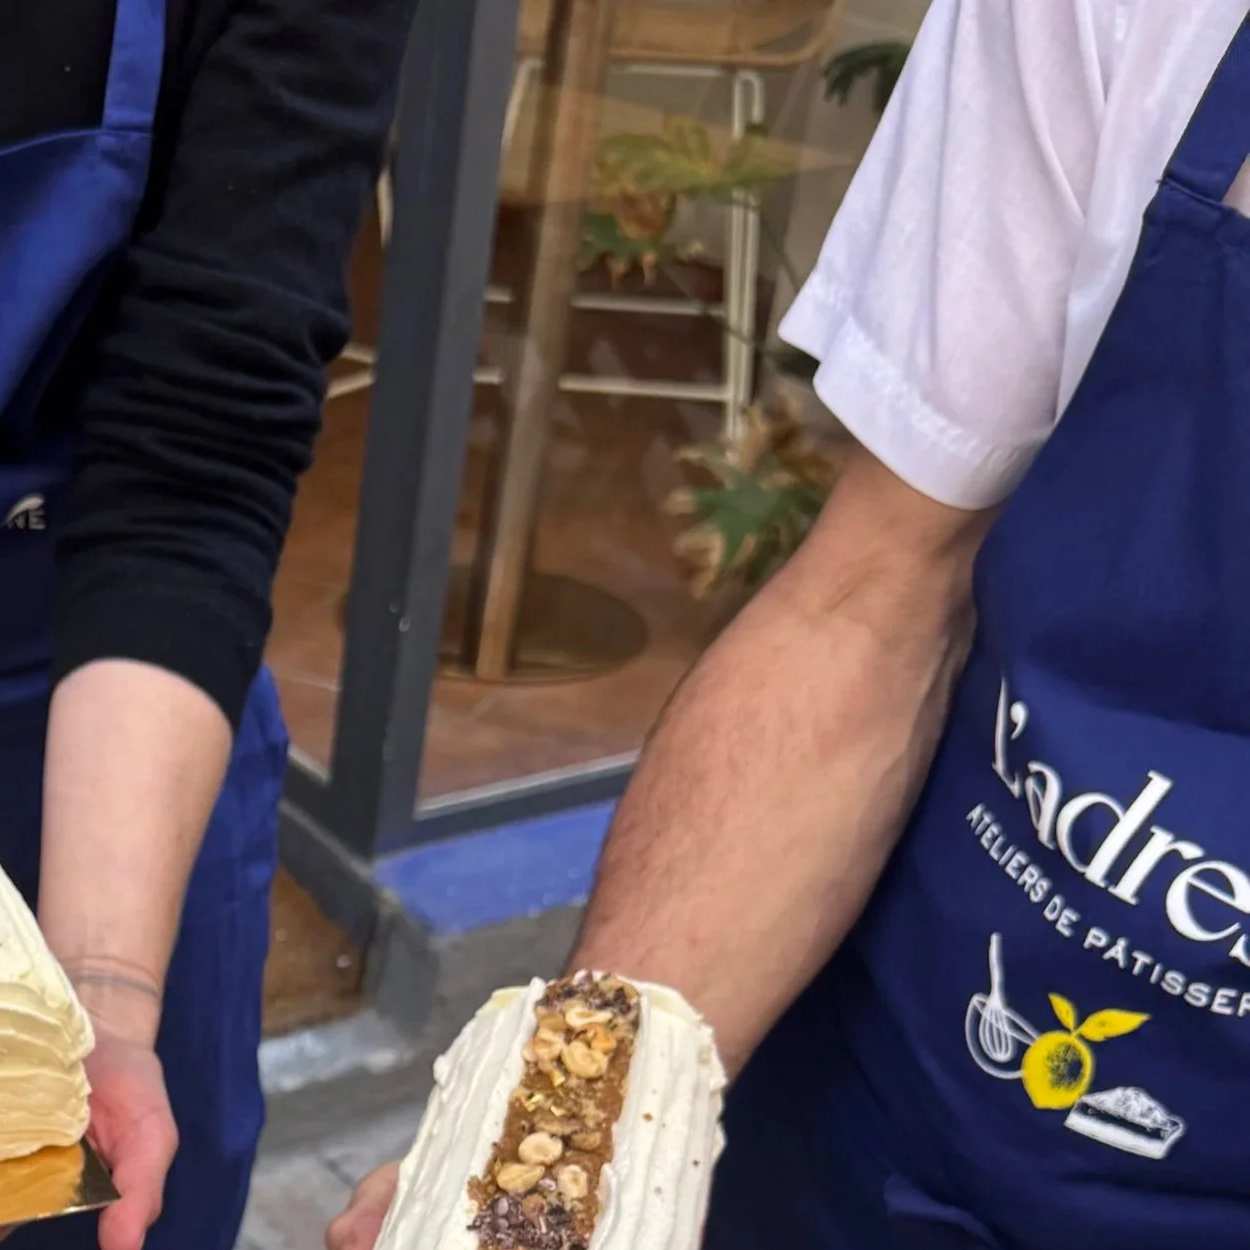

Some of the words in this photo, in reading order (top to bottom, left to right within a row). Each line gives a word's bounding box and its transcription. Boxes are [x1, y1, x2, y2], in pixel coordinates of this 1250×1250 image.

[965, 802, 1053, 903] ATELIERS
[1042, 893, 1082, 938] DE
[991, 676, 1250, 968] L'adre
